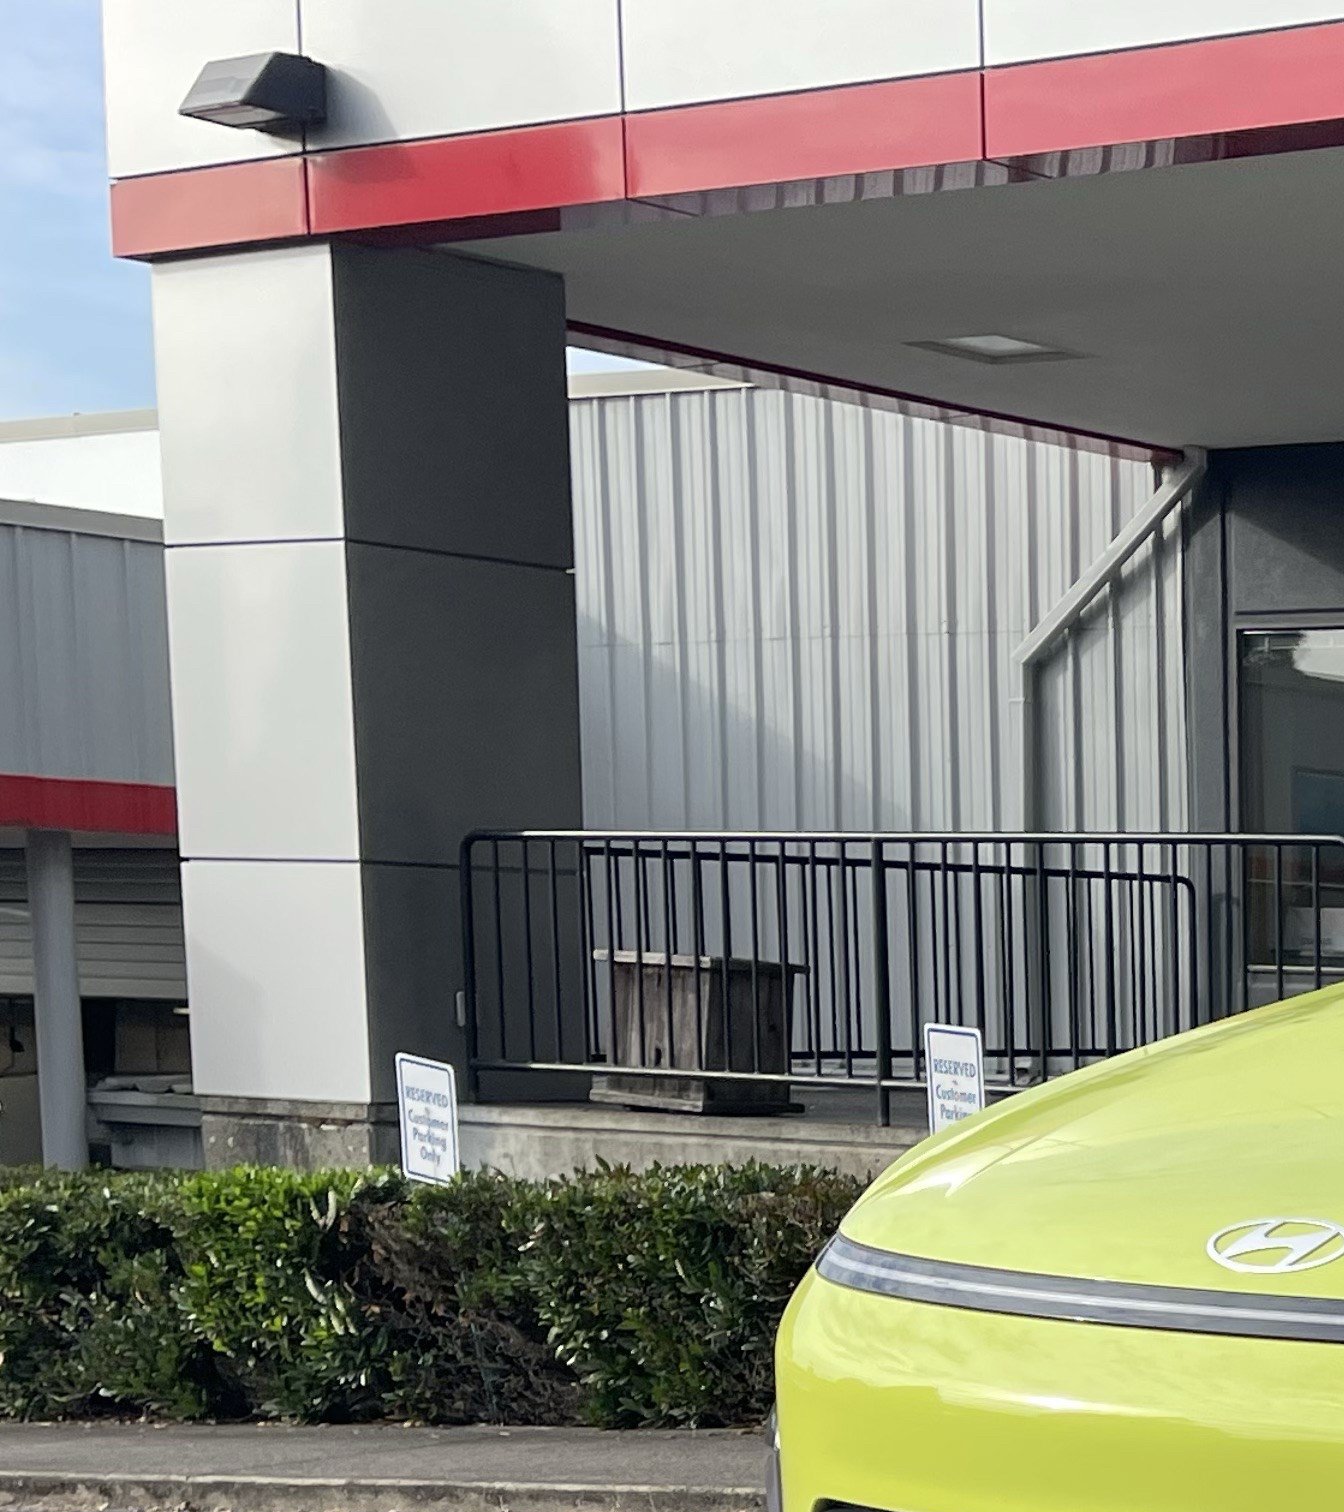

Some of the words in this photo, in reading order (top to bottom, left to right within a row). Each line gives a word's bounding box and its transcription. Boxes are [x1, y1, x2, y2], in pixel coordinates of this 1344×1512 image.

[933, 1058, 976, 1078] RESERVED
[405, 1085, 448, 1108] RESERVED
[936, 1084, 976, 1104] Customer
[408, 1108, 448, 1130] Customer
[412, 1127, 447, 1152] Parking
[420, 1145, 441, 1166] Only
